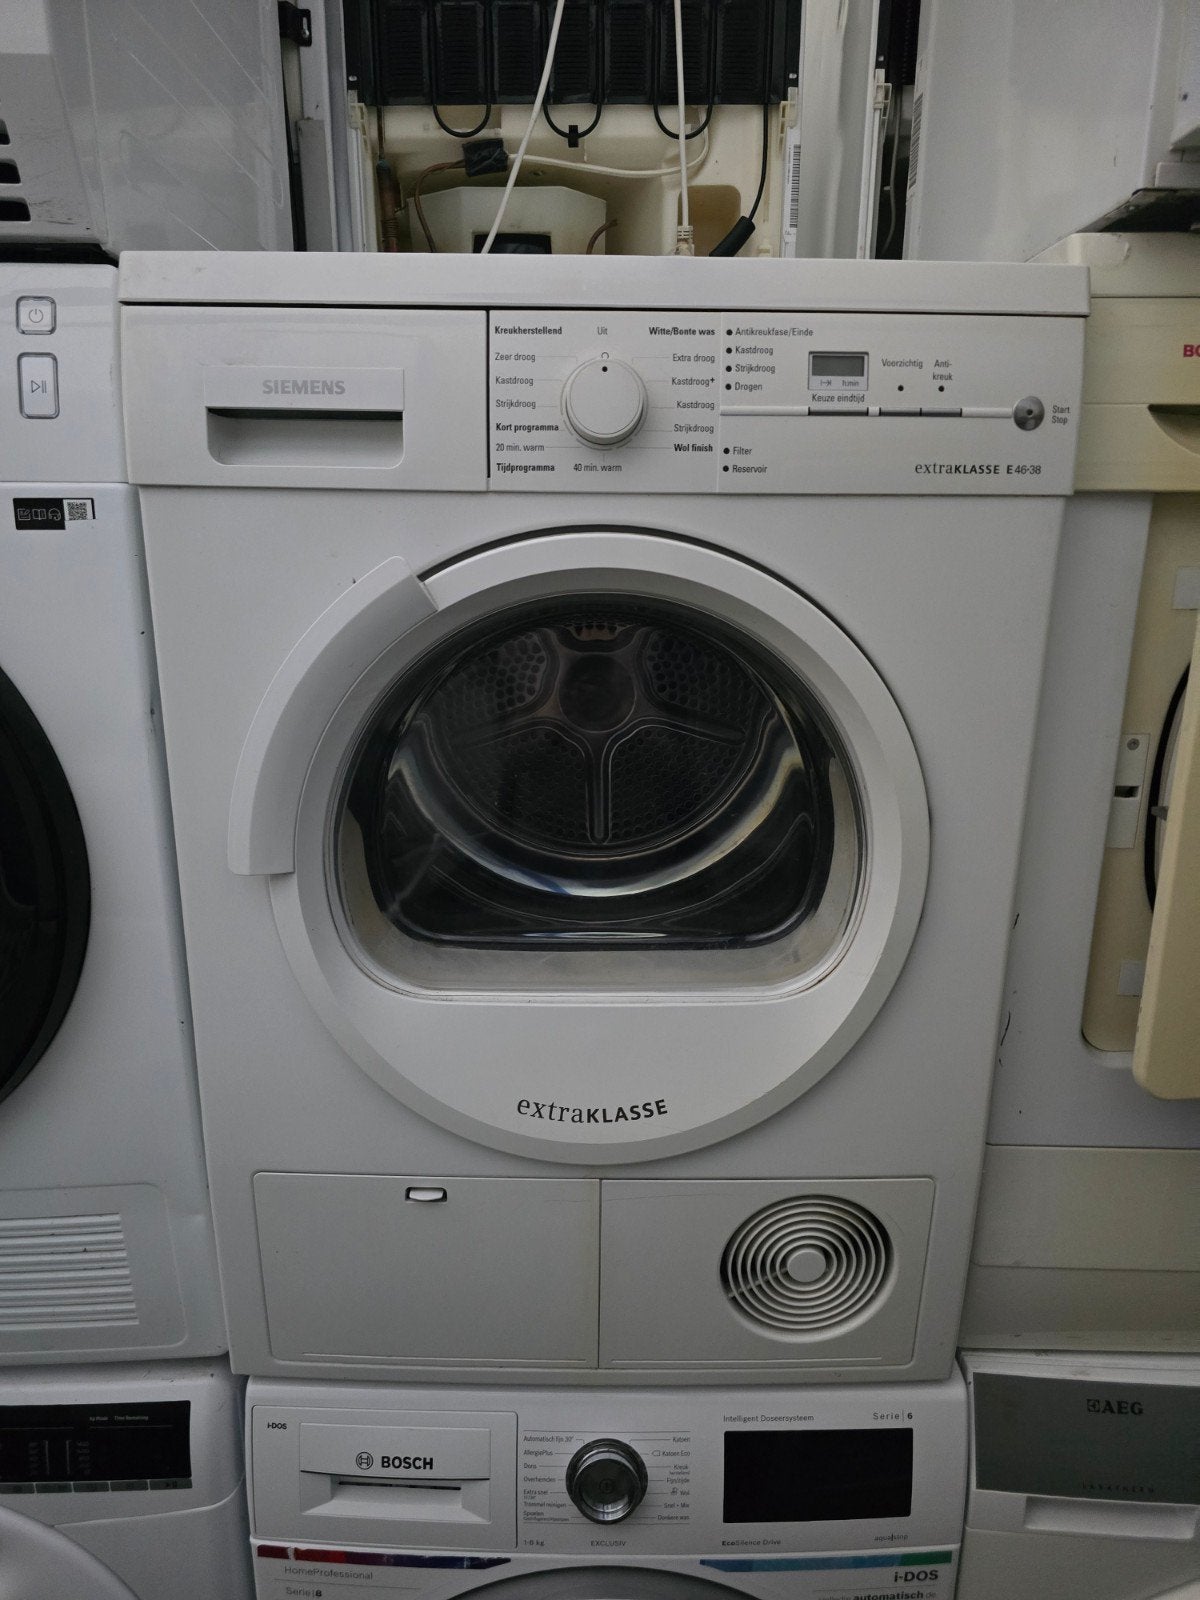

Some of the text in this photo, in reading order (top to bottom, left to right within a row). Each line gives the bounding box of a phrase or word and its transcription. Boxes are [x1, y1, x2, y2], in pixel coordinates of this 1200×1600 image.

[494, 326, 562, 336] Kreukherstellend
[597, 326, 608, 336] Uit
[649, 326, 715, 336] Witte/Bonte was
[735, 327, 814, 338] Antikreukfase/Einde
[735, 346, 774, 357] Kastdroog
[495, 352, 536, 363] Zeer droog
[672, 353, 715, 364] Extra droog
[735, 363, 776, 374] Strijkdroog
[881, 358, 924, 370] Voorzichtig
[934, 359, 952, 369] Anti-
[495, 376, 534, 387] Kastdroog
[932, 372, 953, 381] kreuk
[262, 379, 346, 395] SIEMENS
[734, 382, 763, 393] Drogen
[812, 393, 865, 403] Keuze eindtijd
[495, 399, 536, 410] Strijkdroog
[676, 401, 715, 411] Kastdroog
[1052, 405, 1070, 414] Start
[1051, 415, 1068, 425] Stop
[495, 423, 559, 433] Kort programma
[673, 423, 715, 434] Strijkdroog
[495, 443, 545, 452] 20 min. warm
[674, 443, 713, 452] Wol finish
[732, 447, 752, 456] Filter
[496, 463, 555, 474] Tijdprogramma
[573, 463, 622, 472] 40 min. warm
[732, 464, 768, 474] Reservoir
[914, 462, 1000, 475] extraKLASSE
[517, 1098, 668, 1124] extraKLASSE
[1102, 1399, 1144, 1415] AEG
[723, 1414, 815, 1424] Intelligent Doseersysteem
[872, 1411, 913, 1420] Serie 6
[381, 1456, 434, 1470] BOSCH
[762, 1538, 781, 1546] Drive
[284, 1565, 373, 1580] HomeProfessional
[893, 1569, 939, 1583] i-DOS
[286, 1586, 312, 1598] Serie
